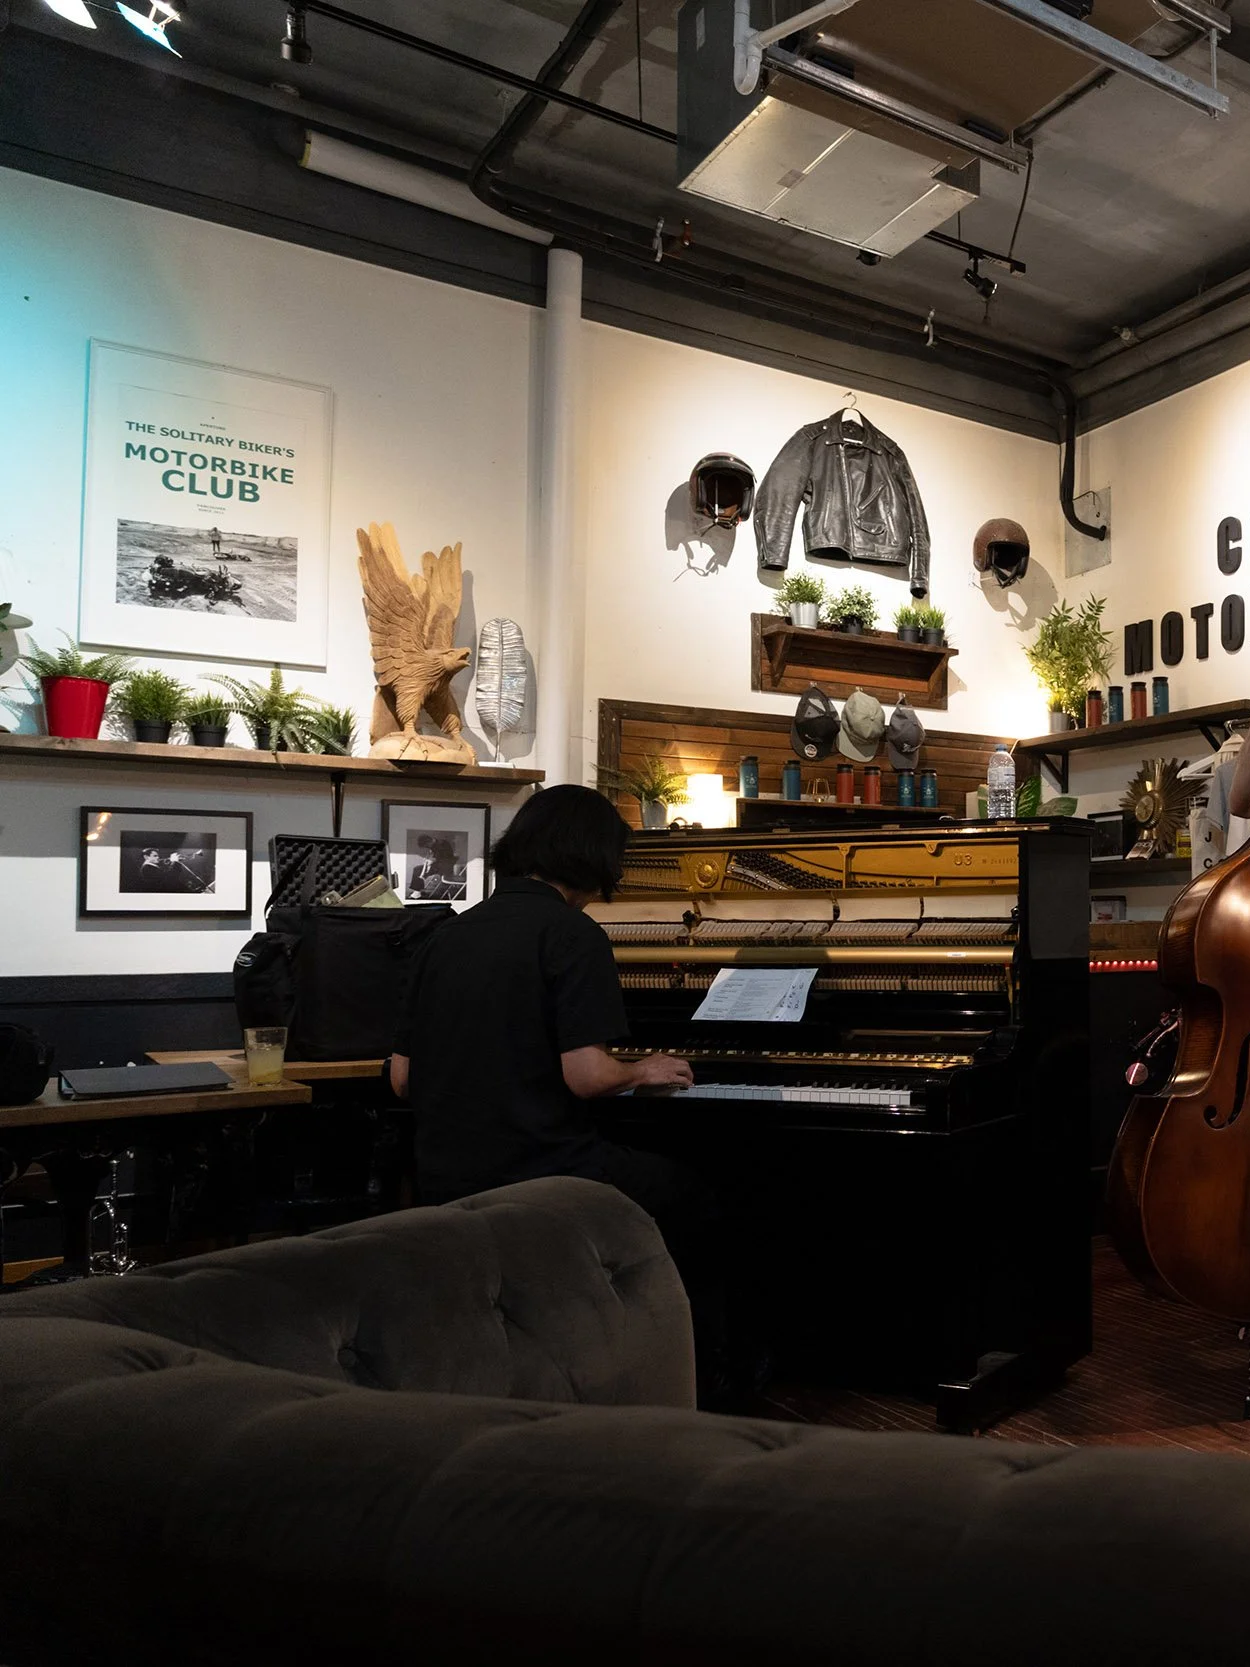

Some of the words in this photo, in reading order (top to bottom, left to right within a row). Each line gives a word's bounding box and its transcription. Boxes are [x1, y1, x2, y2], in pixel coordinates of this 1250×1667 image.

[125, 420, 156, 434] THE
[160, 427, 235, 448] SOLITARY
[238, 440, 295, 458] BIKER'S
[124, 442, 294, 485] MOTORBIKE
[161, 469, 260, 503] CLUB
